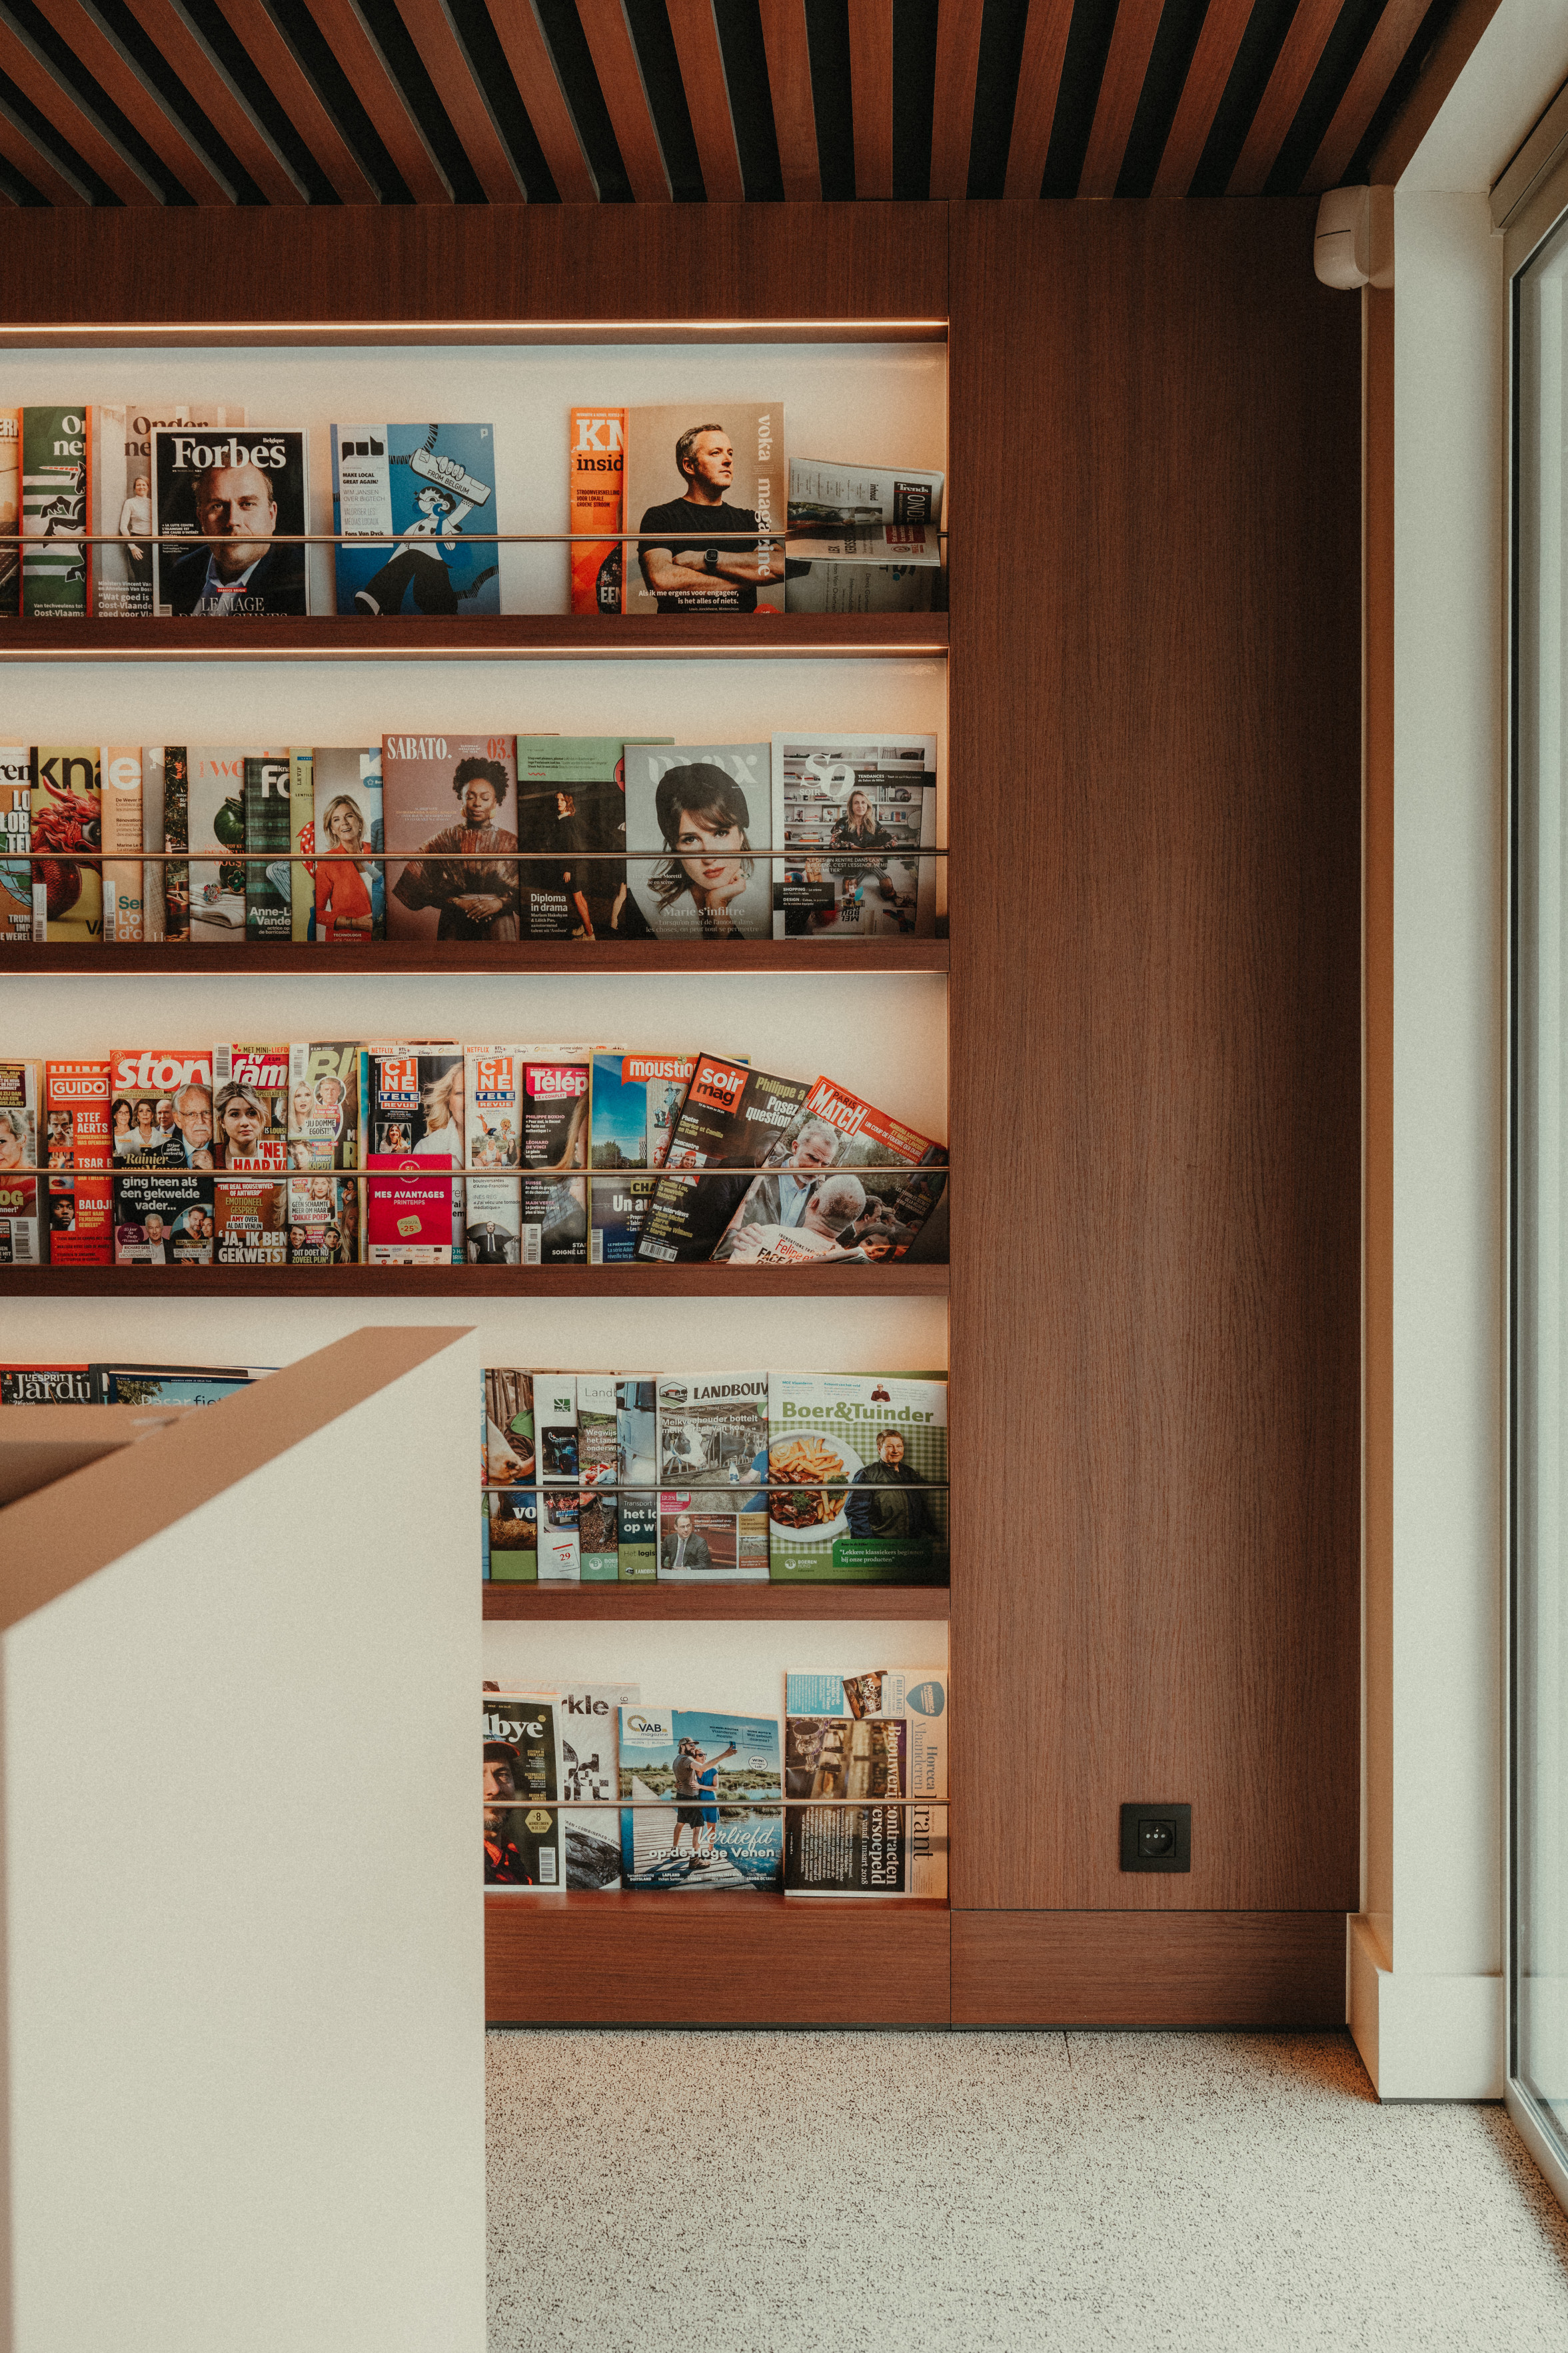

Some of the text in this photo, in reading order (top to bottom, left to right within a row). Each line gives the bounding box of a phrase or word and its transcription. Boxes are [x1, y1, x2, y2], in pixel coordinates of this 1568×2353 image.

[758, 414, 774, 461] voka
[172, 437, 287, 469] Forbes
[427, 469, 470, 495] FROM BELGIUM
[898, 483, 929, 493] Trends
[870, 484, 878, 501] inhoud
[754, 478, 774, 576] magazine
[201, 597, 265, 611] LE MAGE
[387, 738, 452, 759] SABATO.
[531, 894, 566, 904] Diploma
[541, 903, 568, 912] drama
[664, 908, 696, 917] Marie
[248, 1054, 265, 1065] tv
[700, 1069, 743, 1093] soir
[54, 1082, 105, 1094] GUIDO
[755, 1077, 806, 1100] Philippe a
[696, 1083, 735, 1106] mag
[833, 1091, 857, 1109] PARIS
[767, 1096, 799, 1116] Posez
[809, 1083, 868, 1134] MATCH
[77, 1113, 100, 1123] STEF
[682, 1115, 699, 1124] Photos
[77, 1123, 108, 1133] AERTS
[674, 1139, 699, 1150] Rencontre
[871, 1125, 883, 1134] COUP
[888, 1135, 904, 1146] FOUDRE
[910, 1148, 922, 1157] DURE
[78, 1158, 103, 1168] TSAR
[123, 1153, 169, 1165] Rainier
[123, 1177, 198, 1188] ging heen als
[120, 1188, 200, 1200] een gekwelde
[135, 1201, 176, 1210] vader...
[663, 1206, 689, 1218] interviews
[782, 1402, 934, 1423] Boer&Tuinder
[662, 1416, 727, 1425] Melkveehouder
[624, 1509, 644, 1519] het
[624, 1523, 640, 1533] op
[559, 1552, 570, 1561] 29
[926, 1685, 935, 1713] HORECA
[914, 1722, 926, 1789] Vlaanderen
[926, 1746, 938, 1789] Horeca
[698, 1826, 774, 1851] Verliefd
[649, 1847, 774, 1860] op de Hoge Venen
